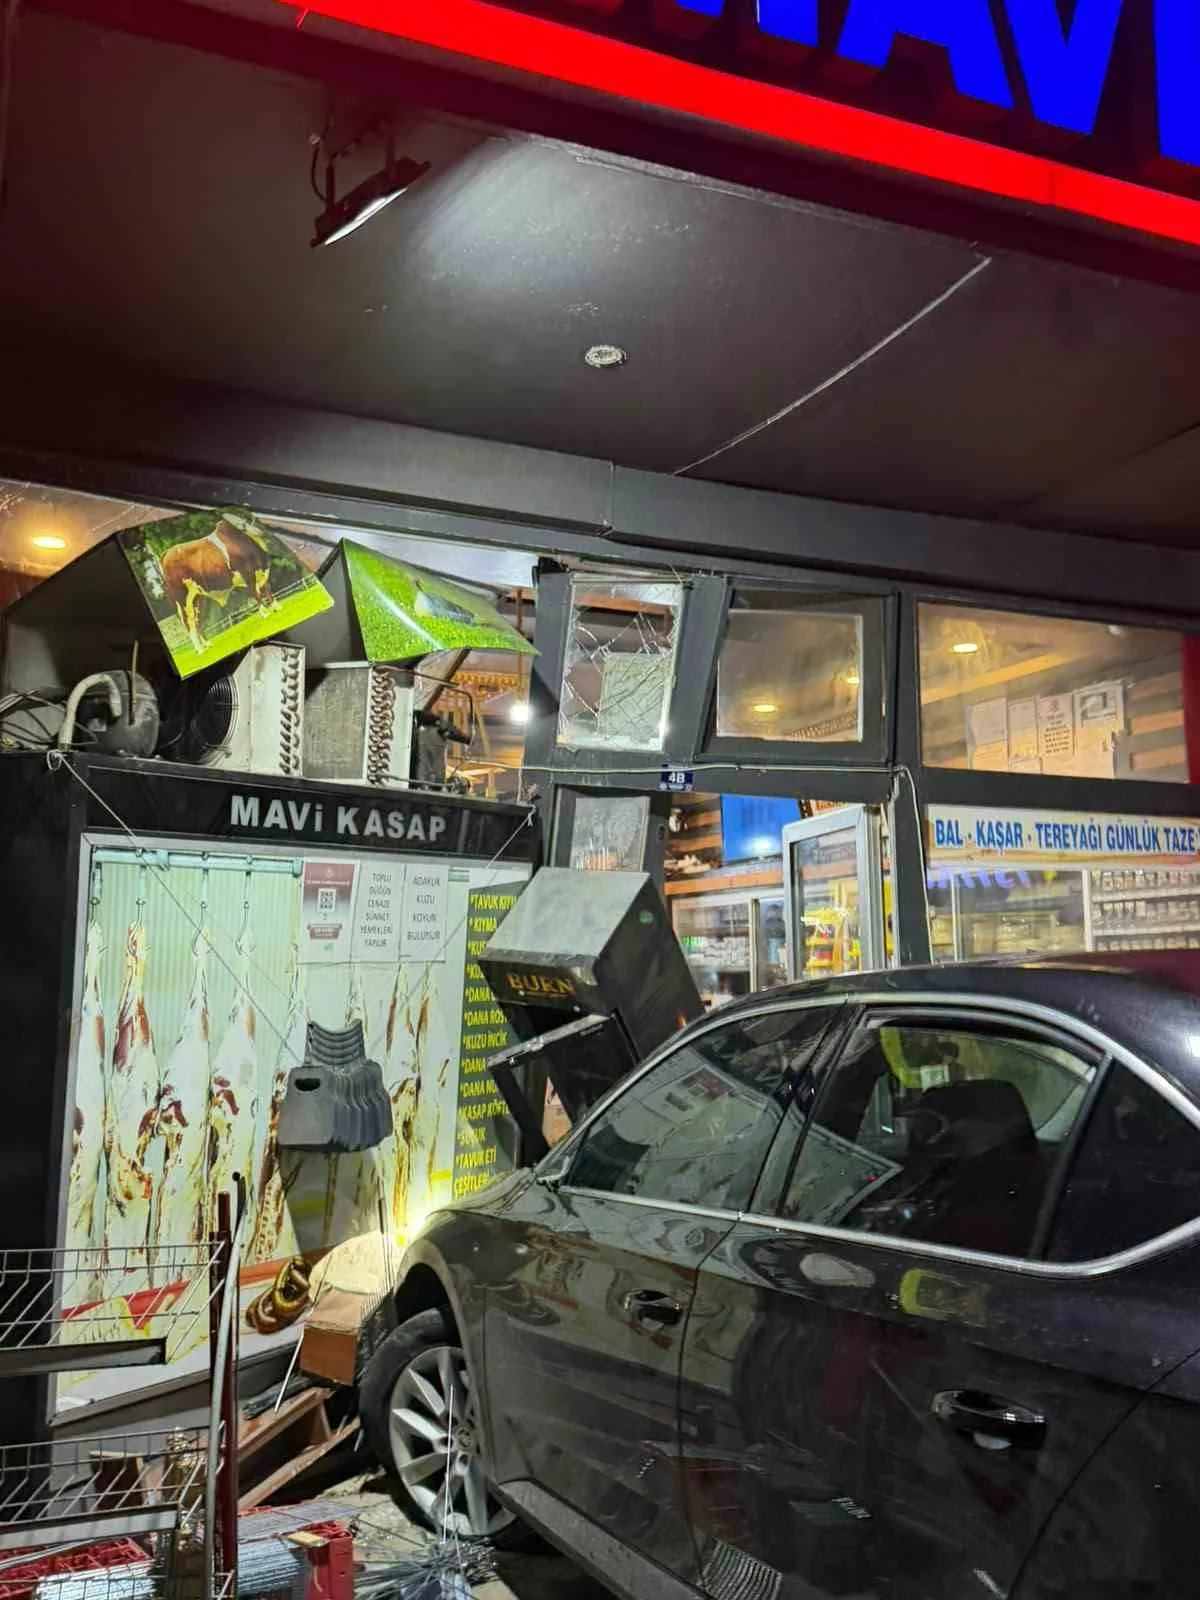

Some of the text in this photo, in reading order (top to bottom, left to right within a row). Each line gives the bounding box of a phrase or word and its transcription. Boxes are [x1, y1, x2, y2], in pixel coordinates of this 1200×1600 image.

[336, 805, 446, 842] KASAP
[935, 819, 964, 845] BAL
[975, 820, 1024, 855] KAŞAR
[1035, 816, 1102, 850] TEREYAĞI
[1105, 818, 1162, 852] GÜNLÜK
